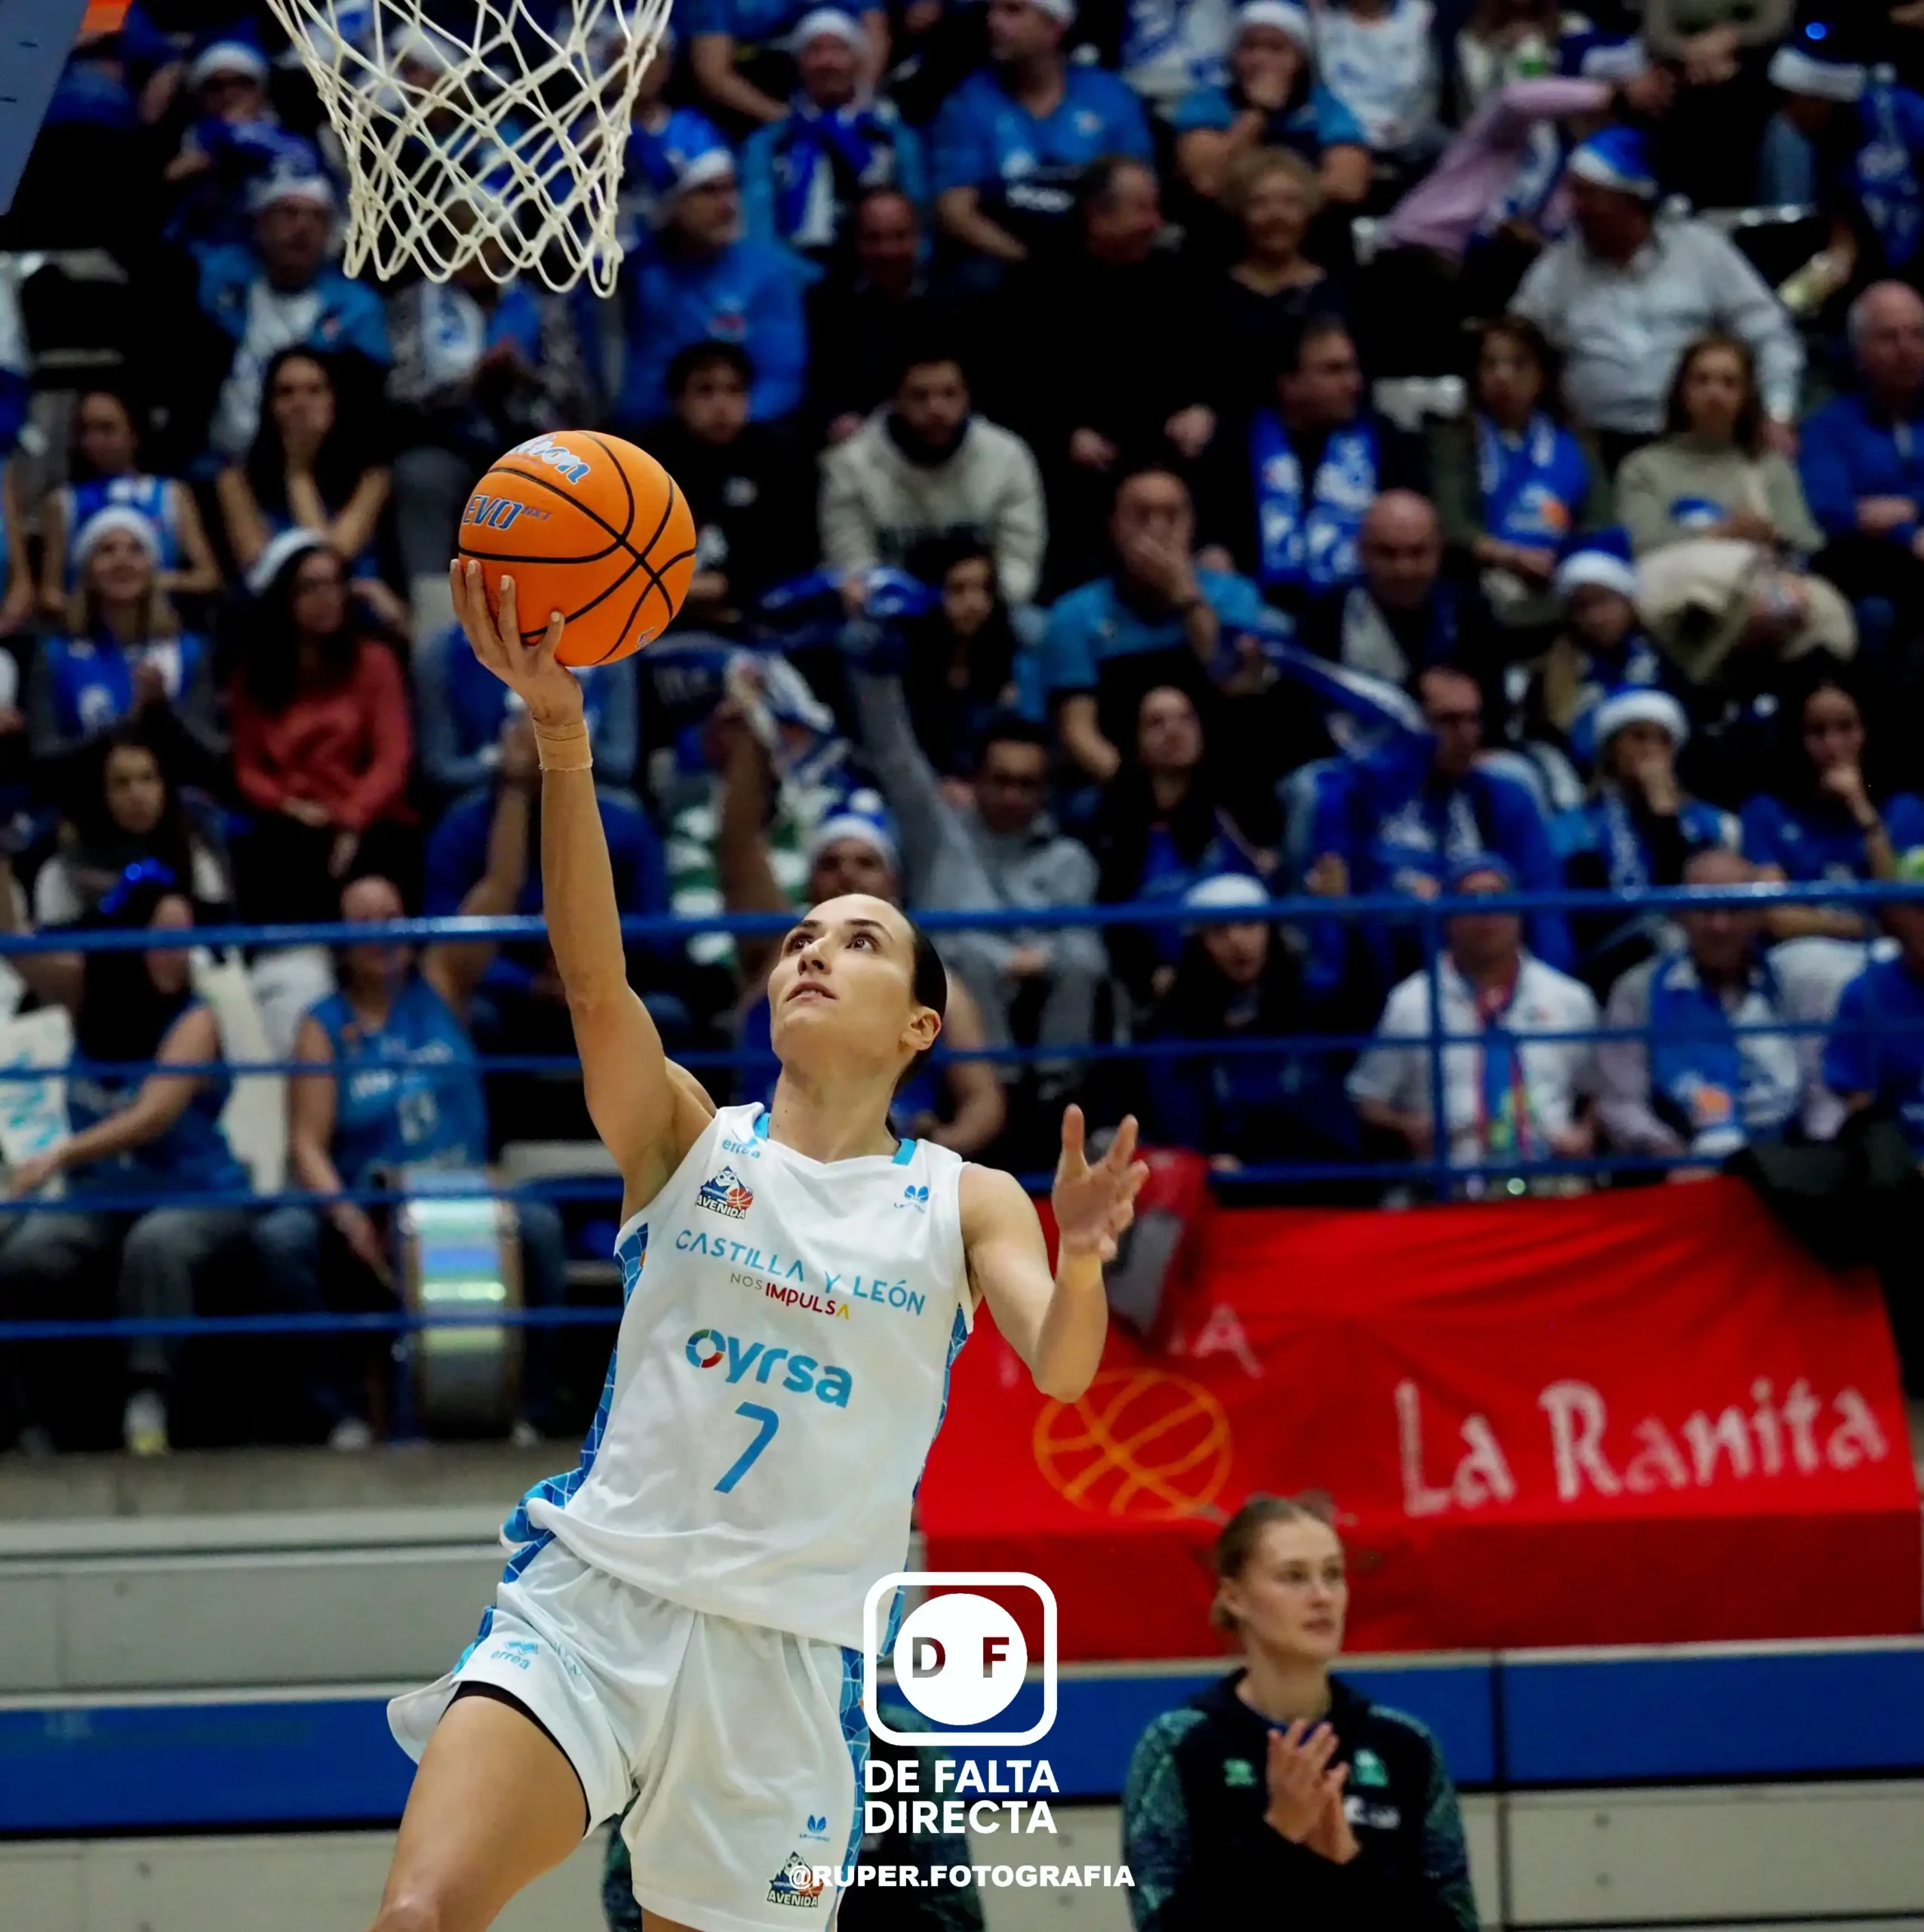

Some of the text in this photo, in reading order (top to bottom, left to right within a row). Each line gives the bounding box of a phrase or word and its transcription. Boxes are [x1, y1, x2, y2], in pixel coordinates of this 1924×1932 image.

[463, 494, 524, 531] EVO
[695, 1195, 747, 1220] AVENIDA
[675, 1229, 926, 1315] CASTILLA Y LEÓN
[730, 1272, 850, 1320] NOS IMPULSA
[714, 1401, 779, 1494] 7
[1394, 1375, 1889, 1518] La Ranita
[767, 1890, 819, 1908] AVENIDA
